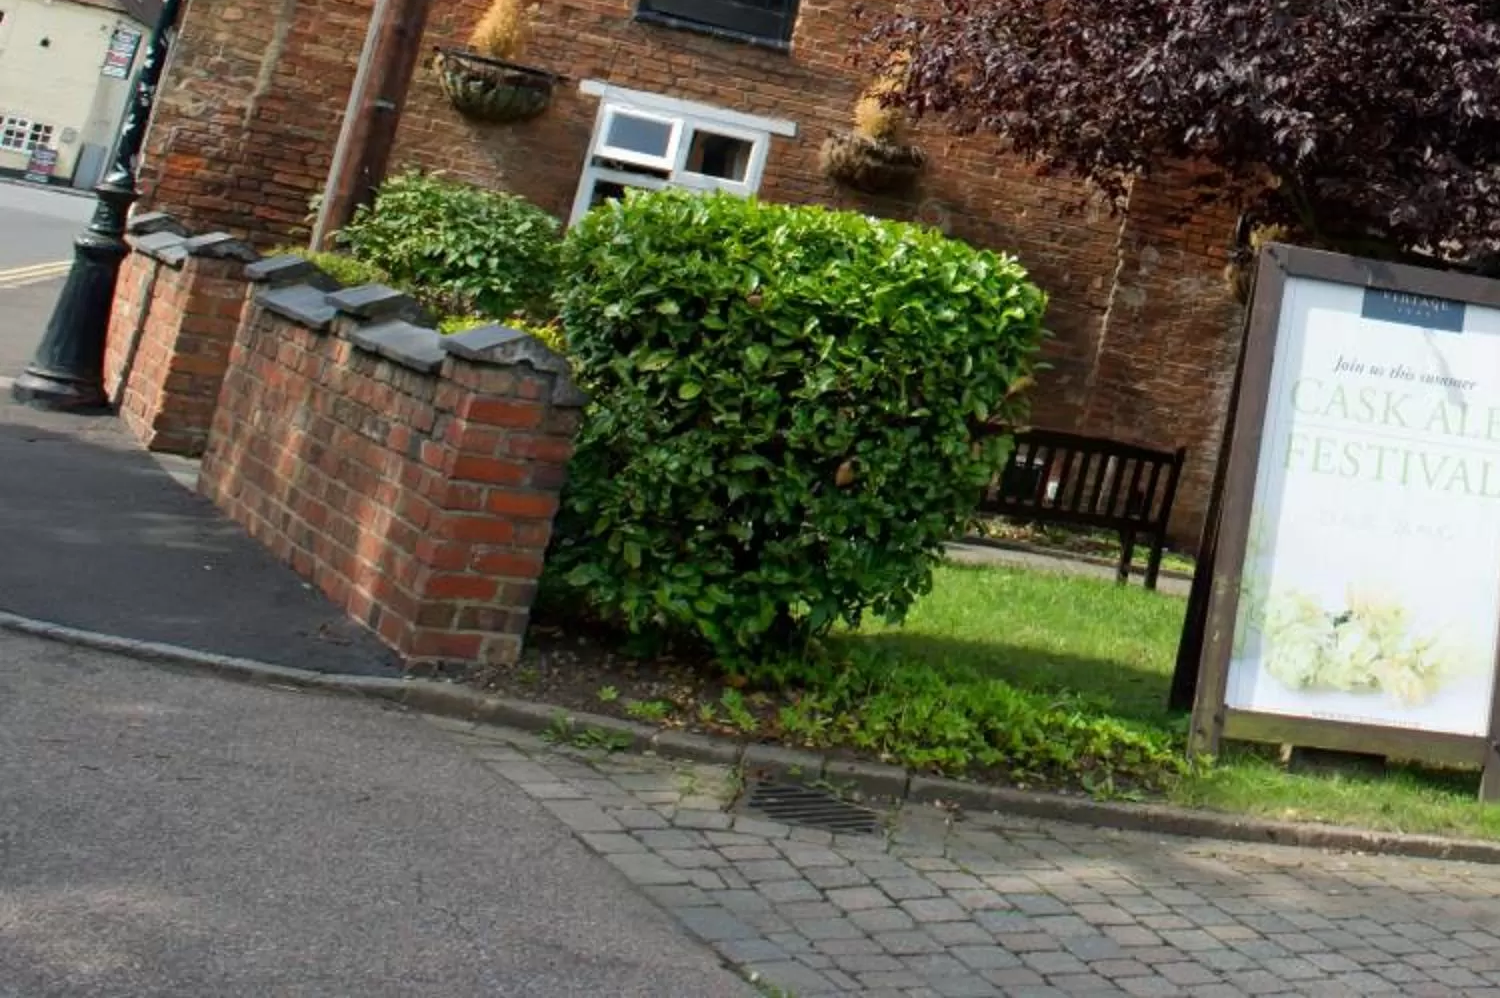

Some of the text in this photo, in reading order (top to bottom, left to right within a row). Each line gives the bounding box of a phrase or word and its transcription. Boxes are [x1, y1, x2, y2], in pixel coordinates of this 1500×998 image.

[1333, 354, 1363, 376] Join
[1389, 363, 1416, 380] this
[1420, 373, 1480, 392] summer
[1290, 376, 1412, 428] CASK
